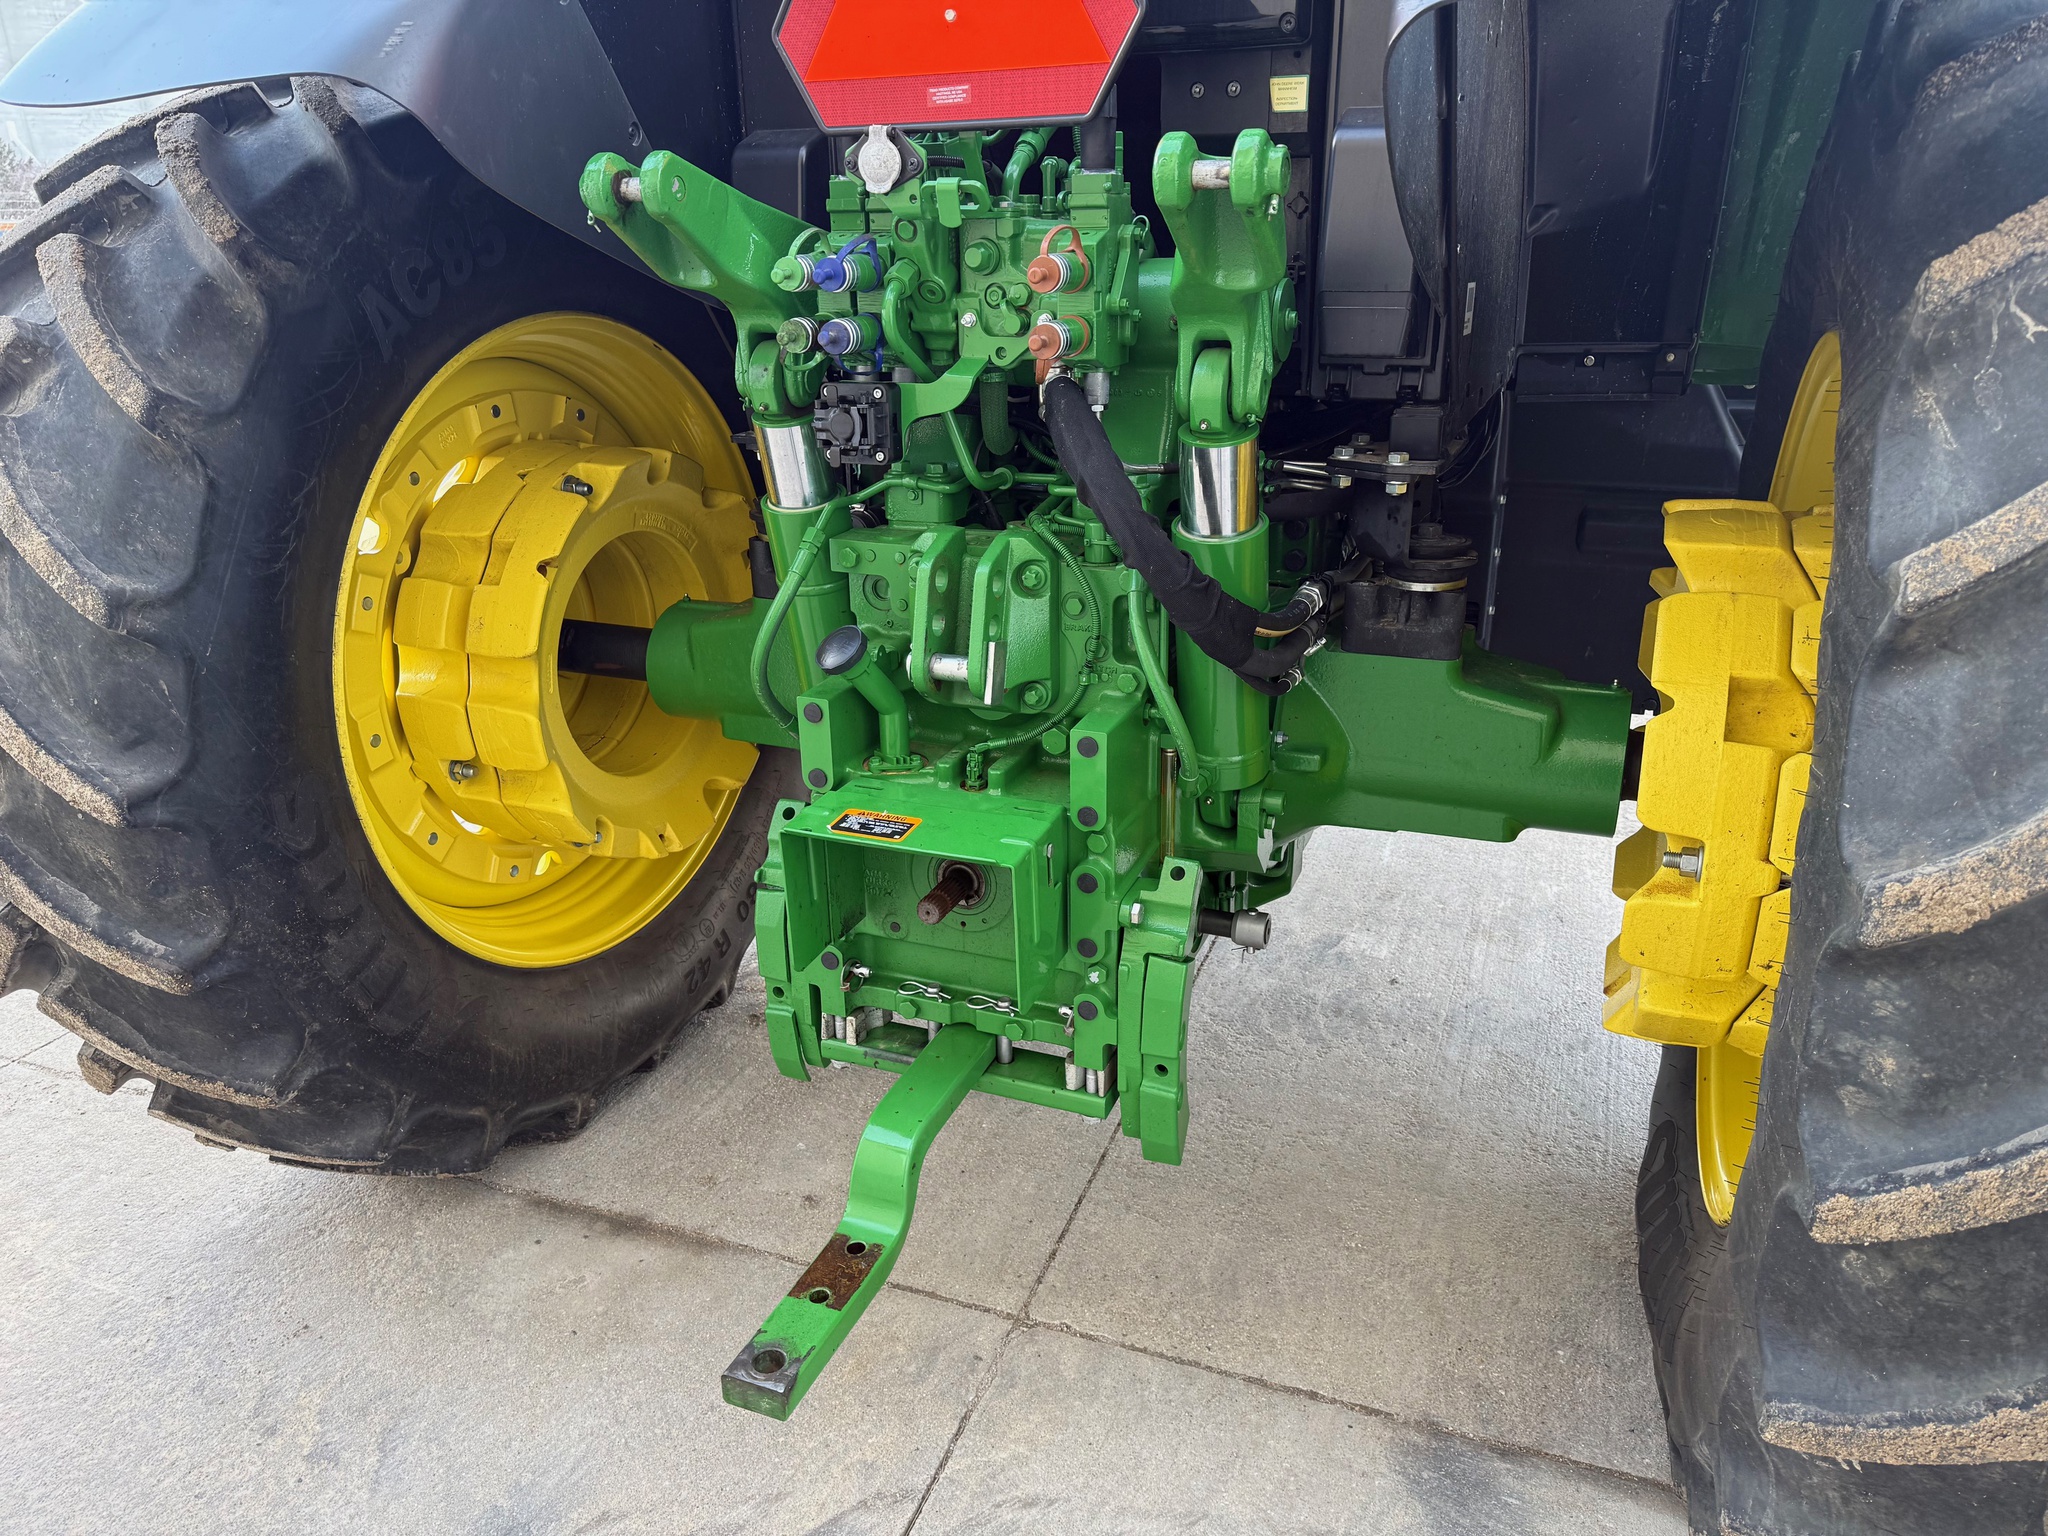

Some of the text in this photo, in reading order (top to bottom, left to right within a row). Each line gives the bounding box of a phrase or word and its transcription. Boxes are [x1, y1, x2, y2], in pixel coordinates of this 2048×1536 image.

[1064, 622, 1093, 633] BRAK
[712, 927, 732, 960] R
[683, 955, 712, 995] 42
